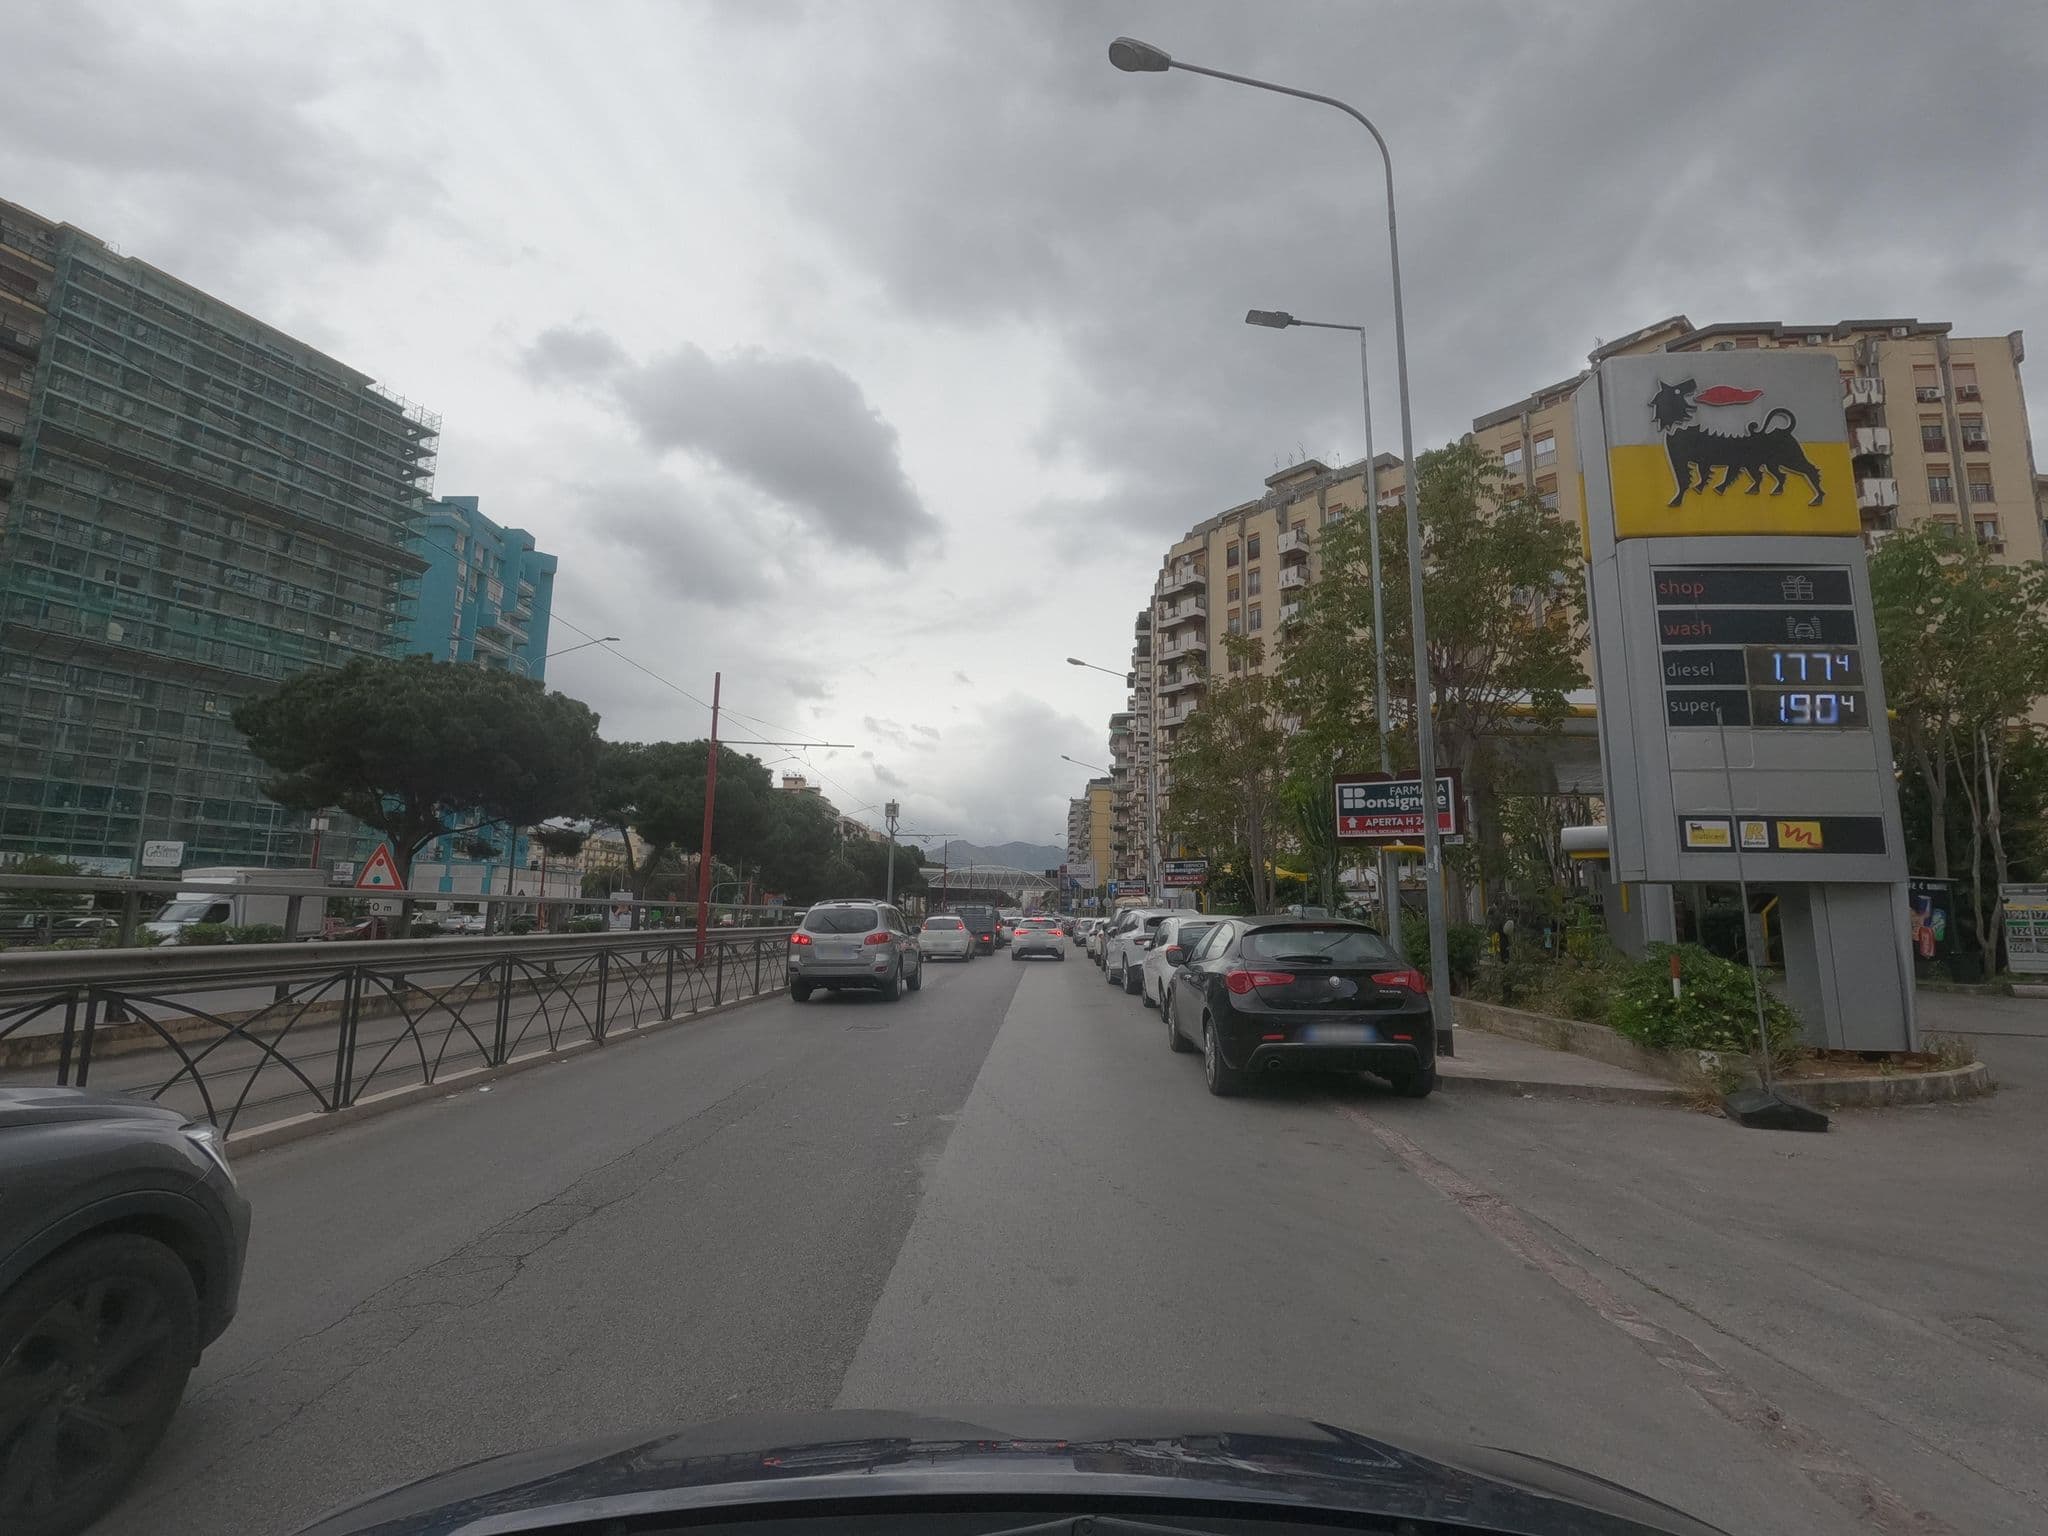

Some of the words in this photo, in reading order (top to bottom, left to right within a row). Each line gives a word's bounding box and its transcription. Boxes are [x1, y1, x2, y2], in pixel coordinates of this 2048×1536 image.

[1658, 580, 1705, 598] shop
[1663, 621, 1712, 636] wash
[1666, 662, 1714, 677] diesel
[1670, 699, 1716, 716] super
[1389, 784, 1445, 795] FARMAA
[1343, 787, 1447, 811] Bonsigne
[1365, 817, 1405, 827] APERTA
